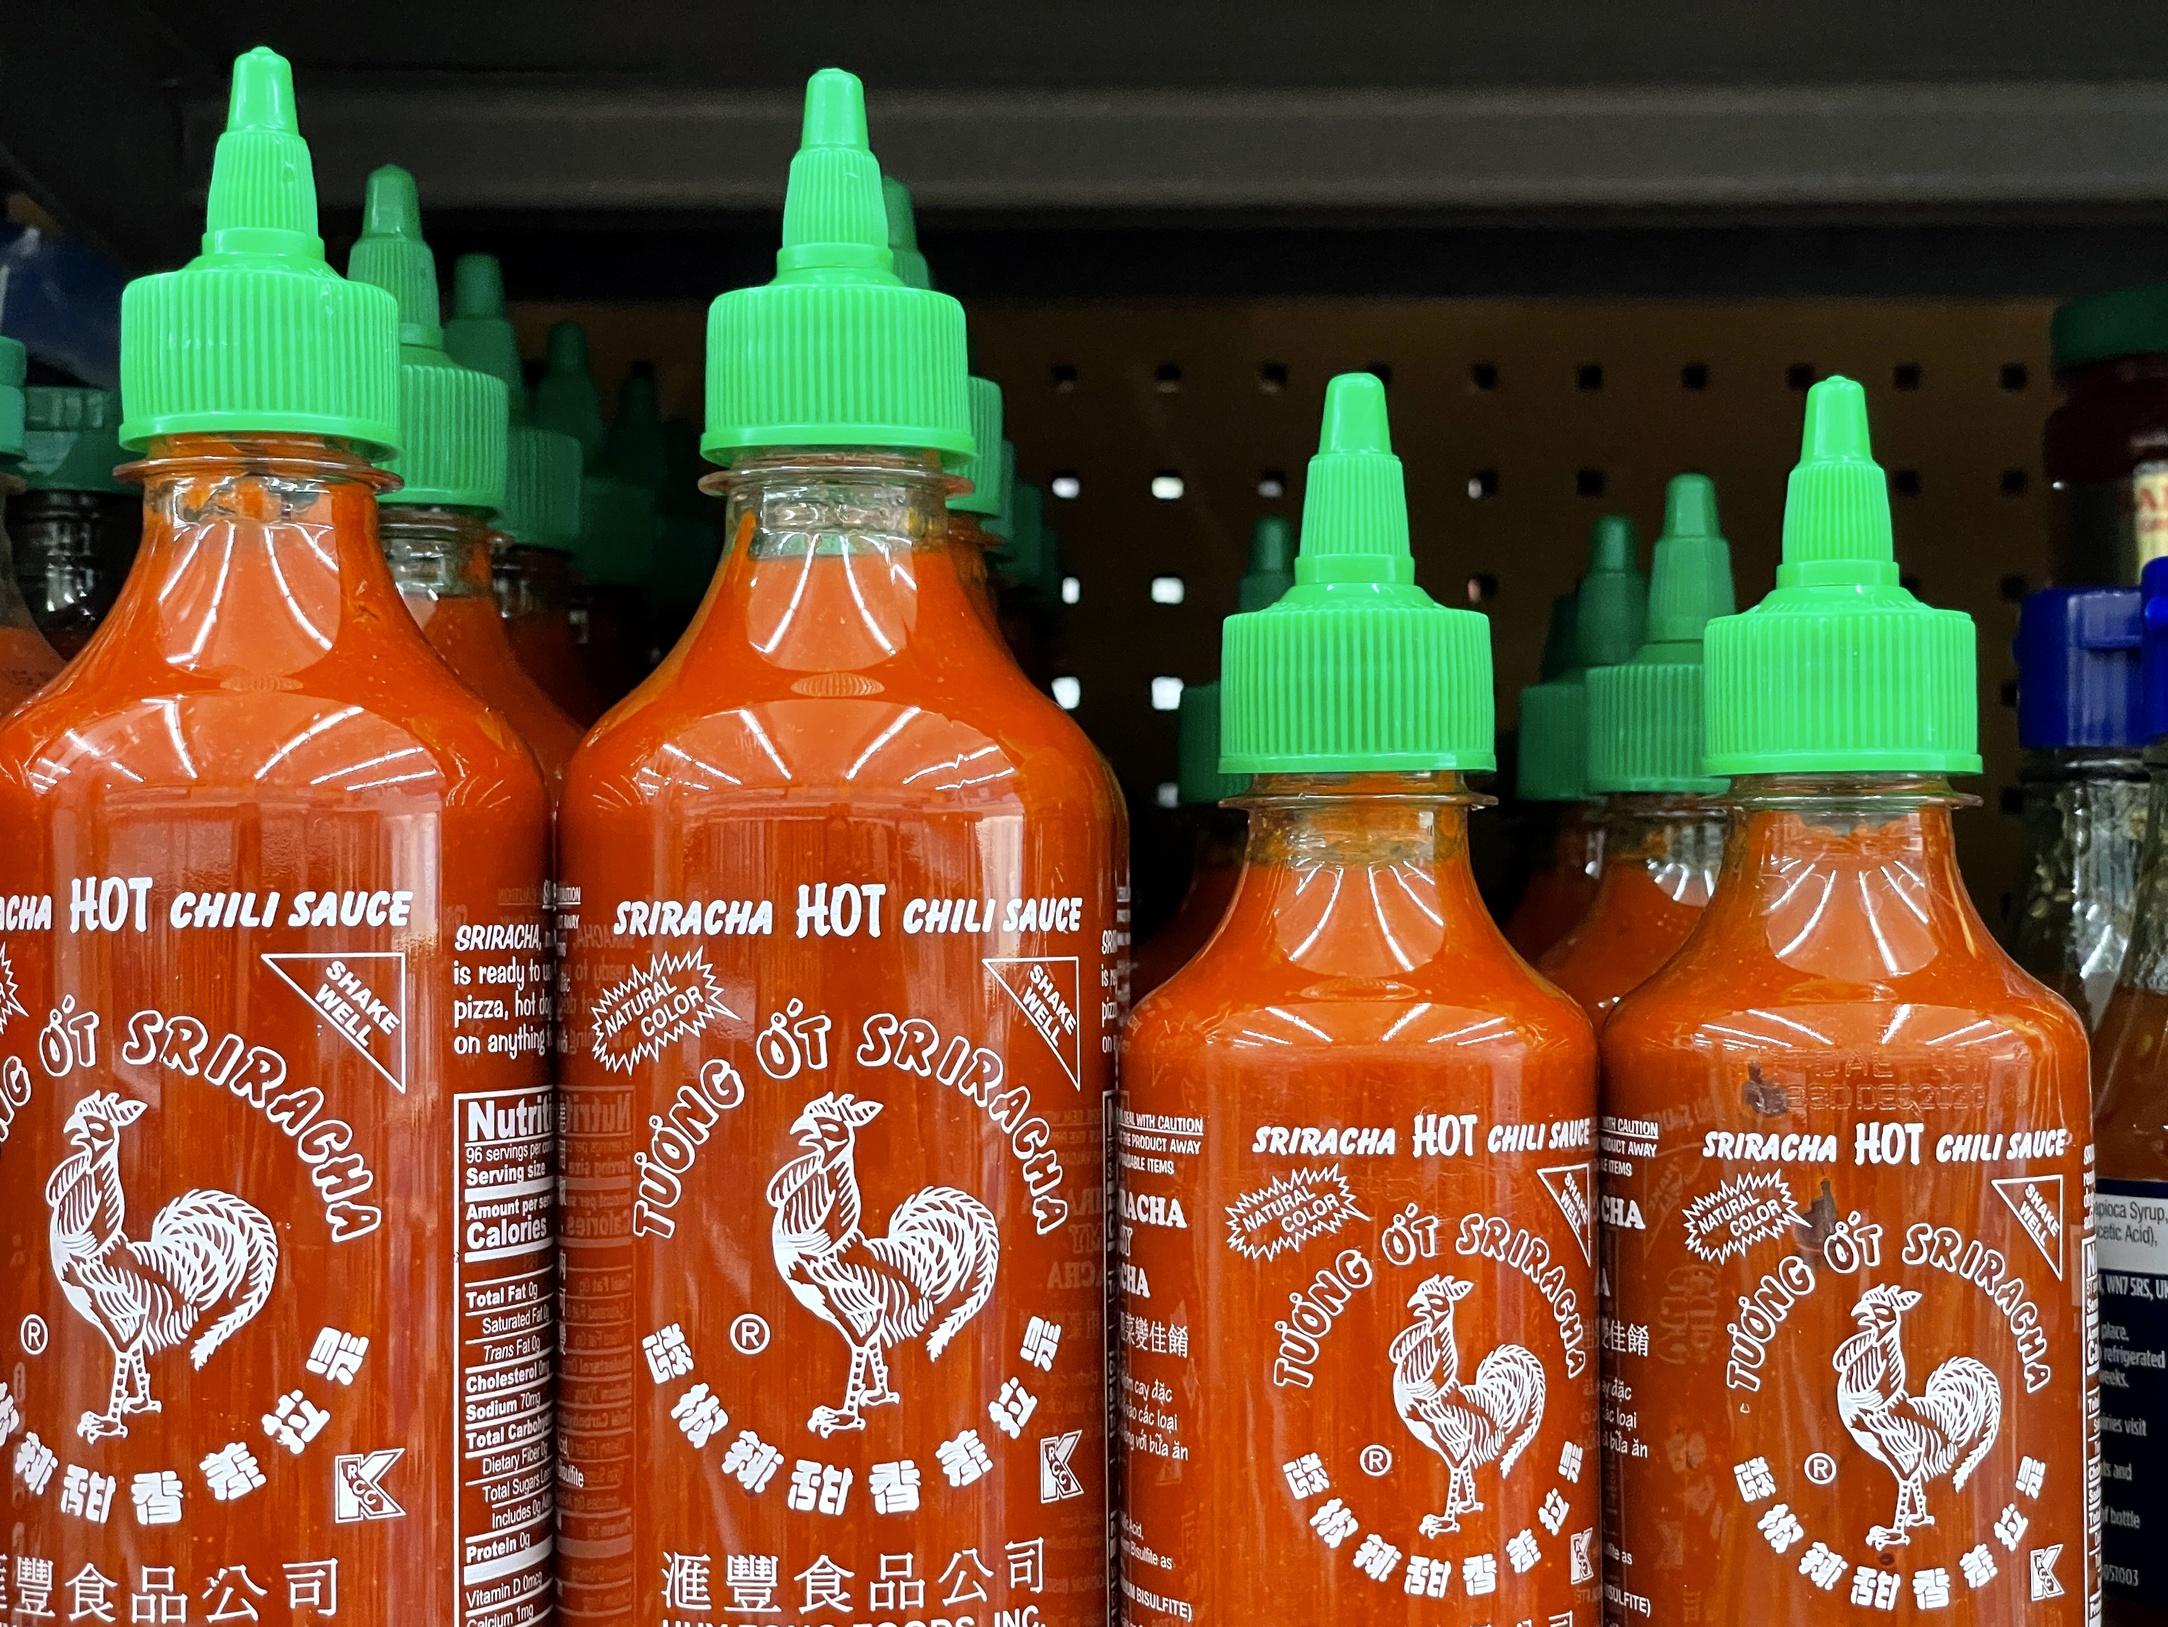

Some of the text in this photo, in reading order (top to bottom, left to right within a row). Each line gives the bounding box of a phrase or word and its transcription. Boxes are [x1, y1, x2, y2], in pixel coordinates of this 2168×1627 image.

[0, 876, 413, 934] CHA HOT CHILI SAUCE
[614, 882, 1083, 938] SRIRACHA HOT CHILI SAUCE
[455, 924, 542, 951] SRIRACHA,
[454, 960, 471, 985] is
[479, 956, 525, 991] ready
[529, 958, 540, 981] to
[325, 959, 400, 1036] SHAKE
[454, 994, 508, 1028] pizza,
[515, 990, 535, 1017] hot
[604, 976, 677, 1038] NATURAL
[640, 985, 703, 1039] COLOR
[1029, 963, 1077, 1036] SHAKE
[314, 983, 375, 1049] WELL
[1022, 986, 1061, 1048] WELL
[454, 1024, 545, 1060] on anything
[123, 1010, 381, 1243] SRIRACHA
[856, 1013, 1068, 1235] SRIRACHA
[1136, 1113, 1203, 1133] WITH CAUTION
[1252, 1114, 1590, 1158] SRIRACHA HOT CHILI SAUCE
[1617, 1118, 1659, 1136] CAUTION
[466, 1147, 482, 1164] 96
[486, 1142, 528, 1162] servings
[530, 1141, 541, 1159] per
[1131, 1135, 1202, 1155] PRODUCT AWAY
[1627, 1140, 1658, 1158] AWAY
[1702, 1122, 2066, 1166] SRIRACHA HOT CHILI SAUCE
[466, 1160, 546, 1187] Serving size
[1147, 1158, 1175, 1175] ITEMS
[466, 1199, 519, 1221] Amount
[522, 1198, 537, 1216] per
[1243, 1183, 1317, 1233] NATURAL
[1280, 1191, 1341, 1234] COLOR
[1557, 1188, 1582, 1234] WELL
[1563, 1172, 1589, 1225] SHAKE
[1698, 1189, 1759, 1237] NATURAL
[2024, 1183, 2061, 1236] SHAKE
[467, 1215, 547, 1250] Calories
[1729, 1196, 1782, 1239] COLOR
[2018, 1200, 2049, 1250] WELL
[466, 1281, 538, 1308] Total Fat 0g
[1456, 1213, 1586, 1379] SRIRACHA
[1902, 1223, 2051, 1393] SRIRACHA
[483, 1309, 531, 1334] Saturated
[532, 1306, 543, 1323] Fat
[484, 1335, 541, 1363] Trans Fat 0g
[2104, 1344, 2166, 1368] refrigerated
[466, 1366, 537, 1393] Cholesterol
[466, 1391, 541, 1422] Sodium 70mg
[466, 1427, 504, 1450] Total
[483, 1452, 519, 1476] Dietary
[483, 1484, 510, 1503] Total
[512, 1475, 540, 1496] Sugars
[492, 1505, 531, 1530] Includes
[466, 1532, 530, 1564] Protein 0g
[1160, 1555, 1173, 1570] as
[466, 1583, 510, 1608] Vitamin
[513, 1578, 521, 1591] D
[1136, 1585, 1192, 1622] BISULFITE)
[516, 1604, 534, 1620] 1mg
